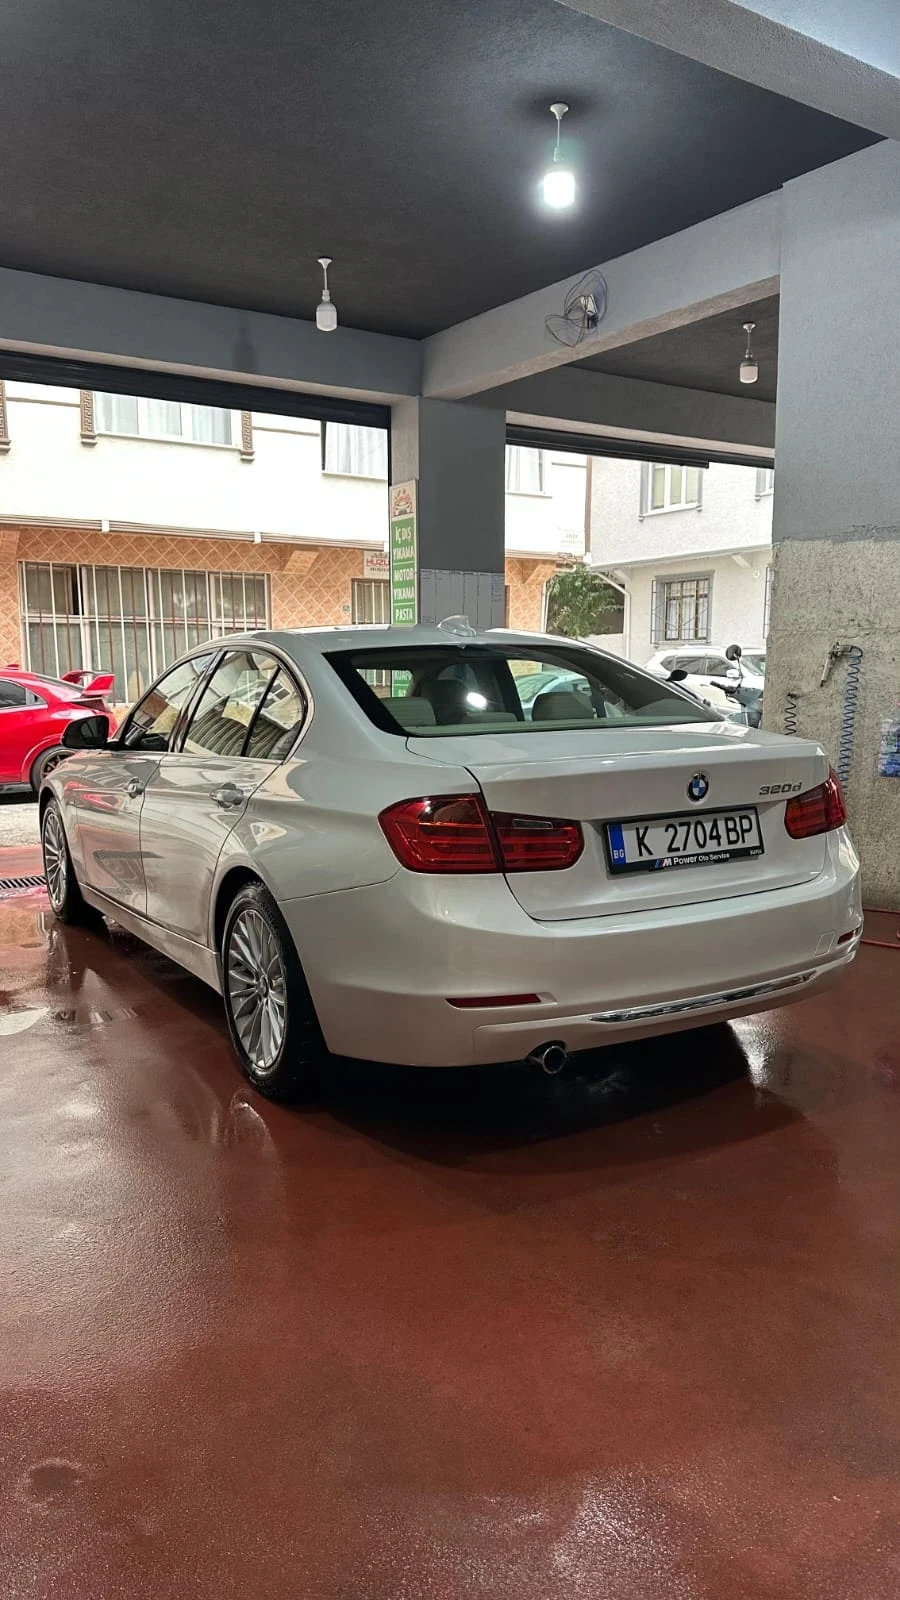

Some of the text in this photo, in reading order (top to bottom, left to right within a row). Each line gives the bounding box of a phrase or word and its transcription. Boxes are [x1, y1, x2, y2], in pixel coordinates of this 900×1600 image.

[393, 545, 415, 561] YIKAMA
[394, 568, 414, 581] MOTOR
[394, 586, 415, 600] YIKAMA
[395, 608, 413, 621] PASTA
[759, 782, 802, 795] 320d
[635, 826, 654, 857] K
[613, 849, 625, 859] BG
[673, 855, 698, 865] Power
[709, 852, 730, 861] Service
